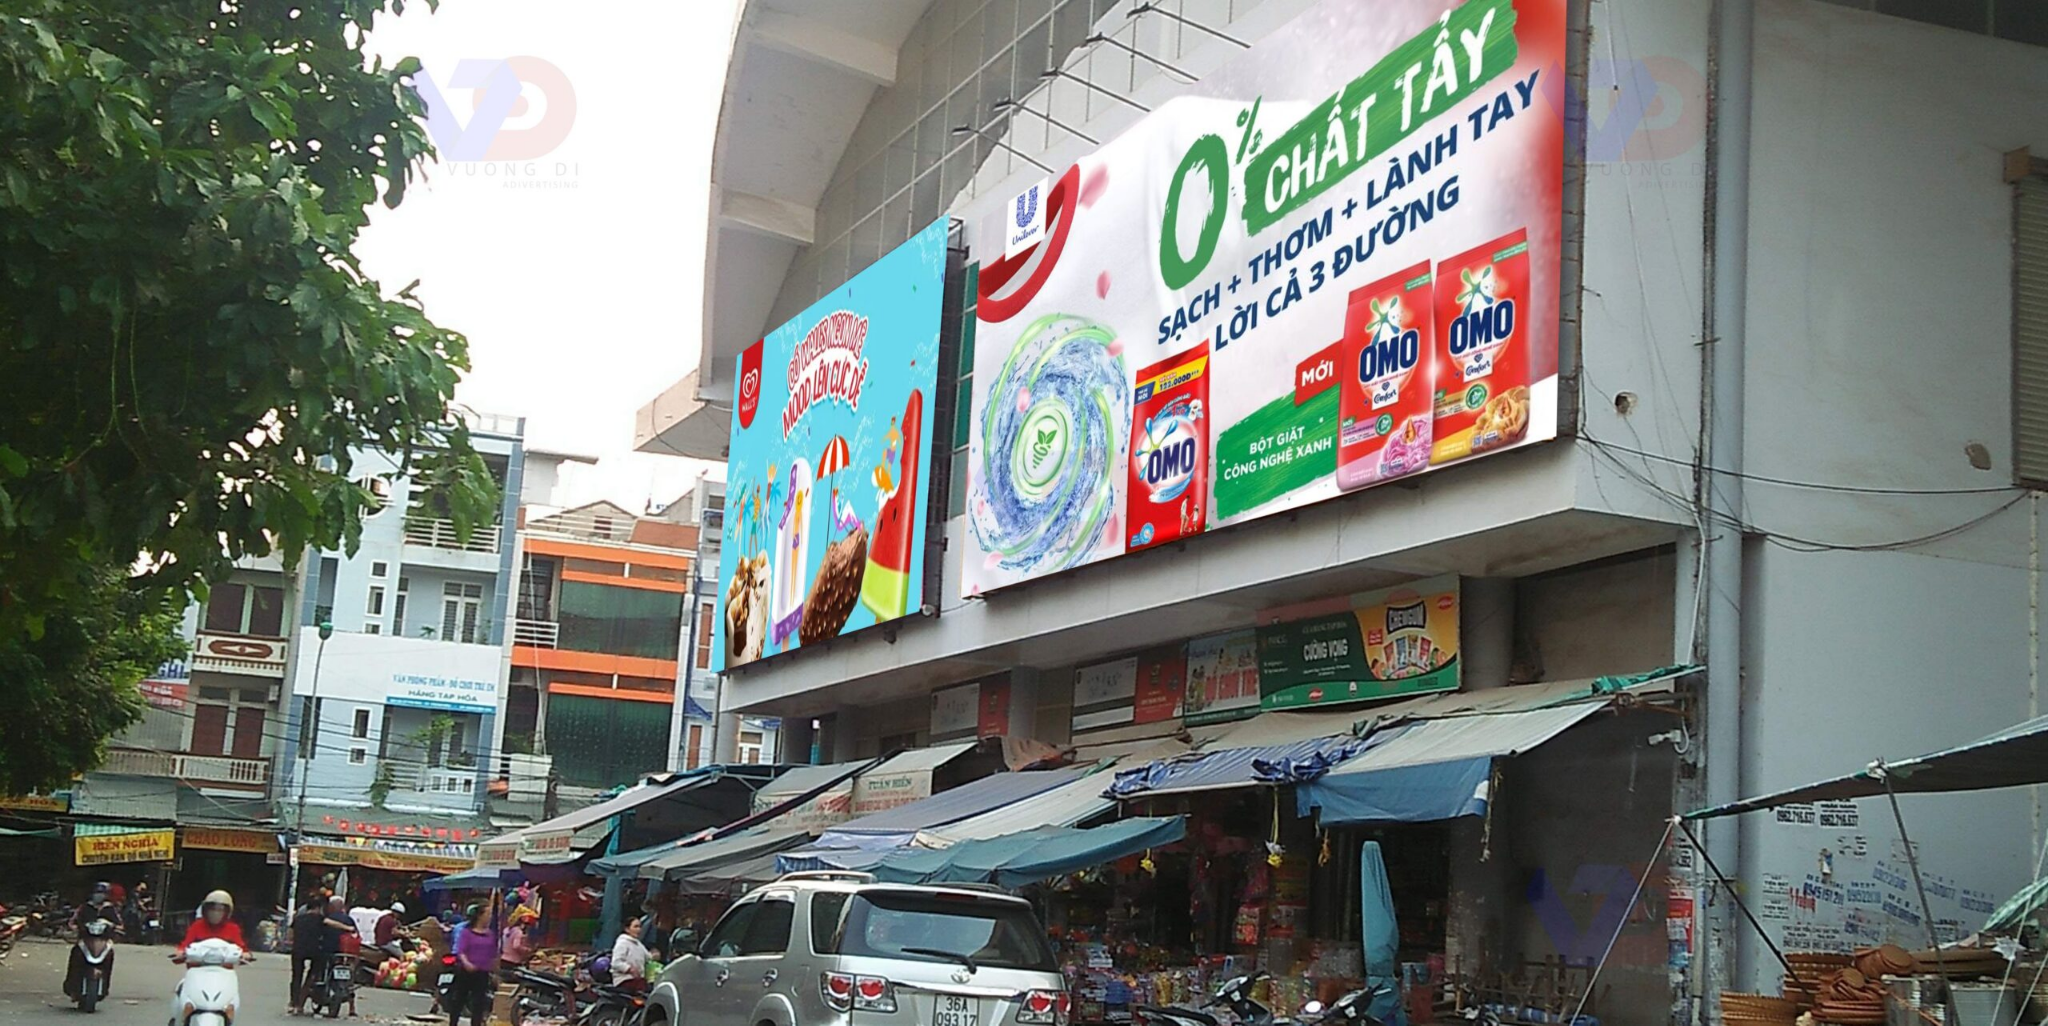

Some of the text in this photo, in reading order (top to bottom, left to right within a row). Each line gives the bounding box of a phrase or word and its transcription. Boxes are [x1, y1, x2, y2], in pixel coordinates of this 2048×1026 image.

[1264, 86, 1377, 213] CHẤT
[1394, 8, 1495, 132] TẨY
[1158, 69, 1540, 345] SẠCH + THƠM + LÀNH TAY
[1012, 226, 1038, 245] Unilever
[1215, 300, 1258, 350] LỜI
[1267, 269, 1302, 317] CẢ
[1309, 261, 1325, 292] 3
[1333, 175, 1459, 279] ĐƯỜNG
[1450, 300, 1513, 354] OMO
[1302, 360, 1333, 387] MỚI
[1359, 331, 1418, 383] OMO
[1466, 360, 1490, 376] Comfort
[783, 377, 811, 438] MOOD
[813, 359, 830, 401] LÊN
[831, 356, 850, 401] CỰC
[1374, 389, 1397, 404] Comfort
[1147, 438, 1195, 484] OMO
[1224, 437, 1332, 480] CÔNG NGHỆ XANH
[1249, 427, 1305, 455] BỘT GIẶT
[946, 996, 968, 1012] 36A
